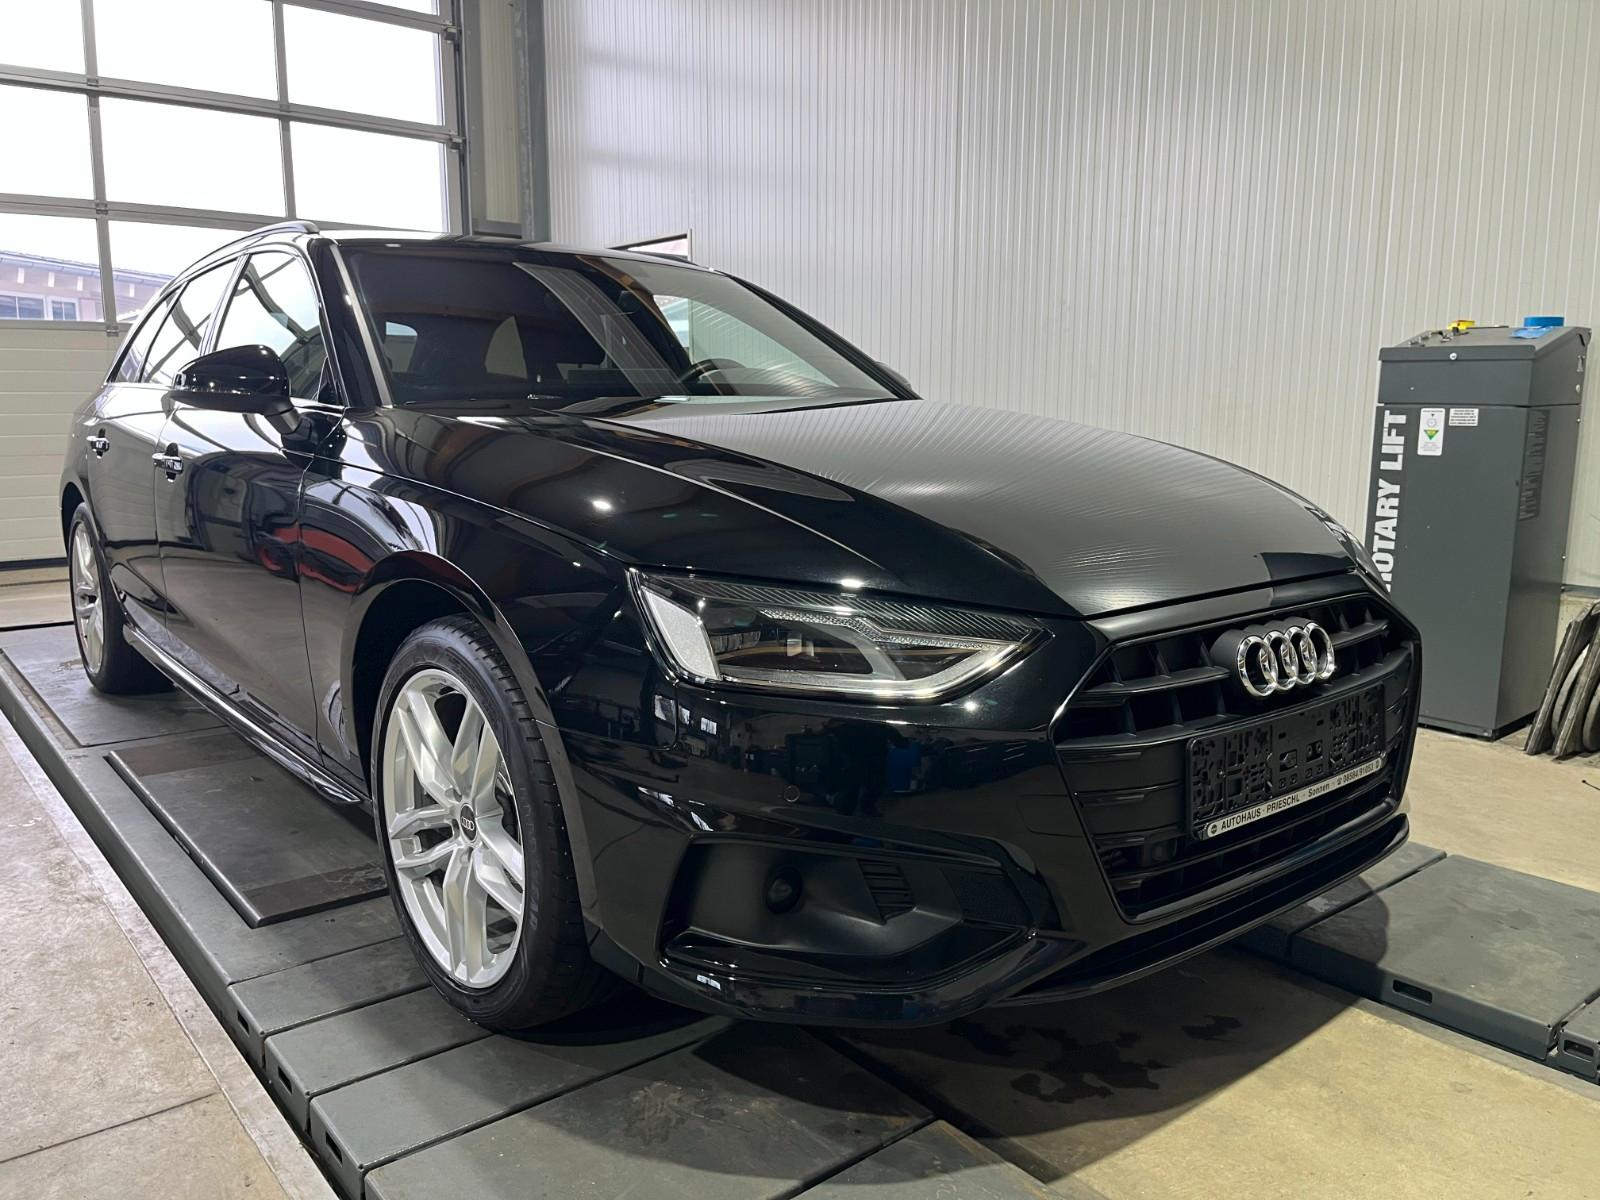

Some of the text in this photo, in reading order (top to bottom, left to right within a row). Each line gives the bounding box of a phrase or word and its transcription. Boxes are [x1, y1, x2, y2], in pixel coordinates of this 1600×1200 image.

[1380, 410, 1407, 471] LIFT
[1221, 807, 1261, 830] AUTOHAUS
[1266, 794, 1300, 814] PRIESCHL
[1308, 783, 1330, 798] Sonnen
